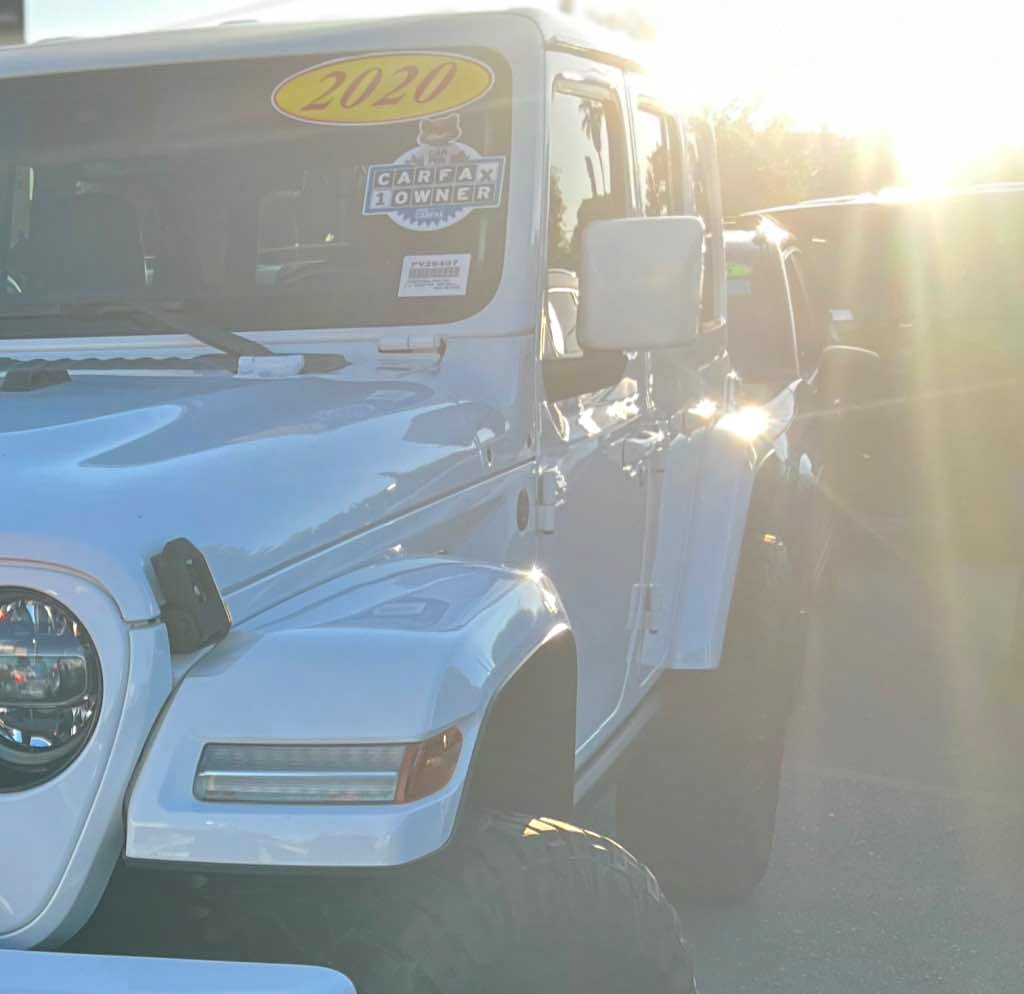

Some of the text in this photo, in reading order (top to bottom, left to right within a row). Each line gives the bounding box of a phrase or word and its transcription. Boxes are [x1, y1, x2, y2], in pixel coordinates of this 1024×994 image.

[301, 62, 458, 112] 2020
[377, 165, 496, 186] CARFAX
[394, 186, 491, 205] OWNER
